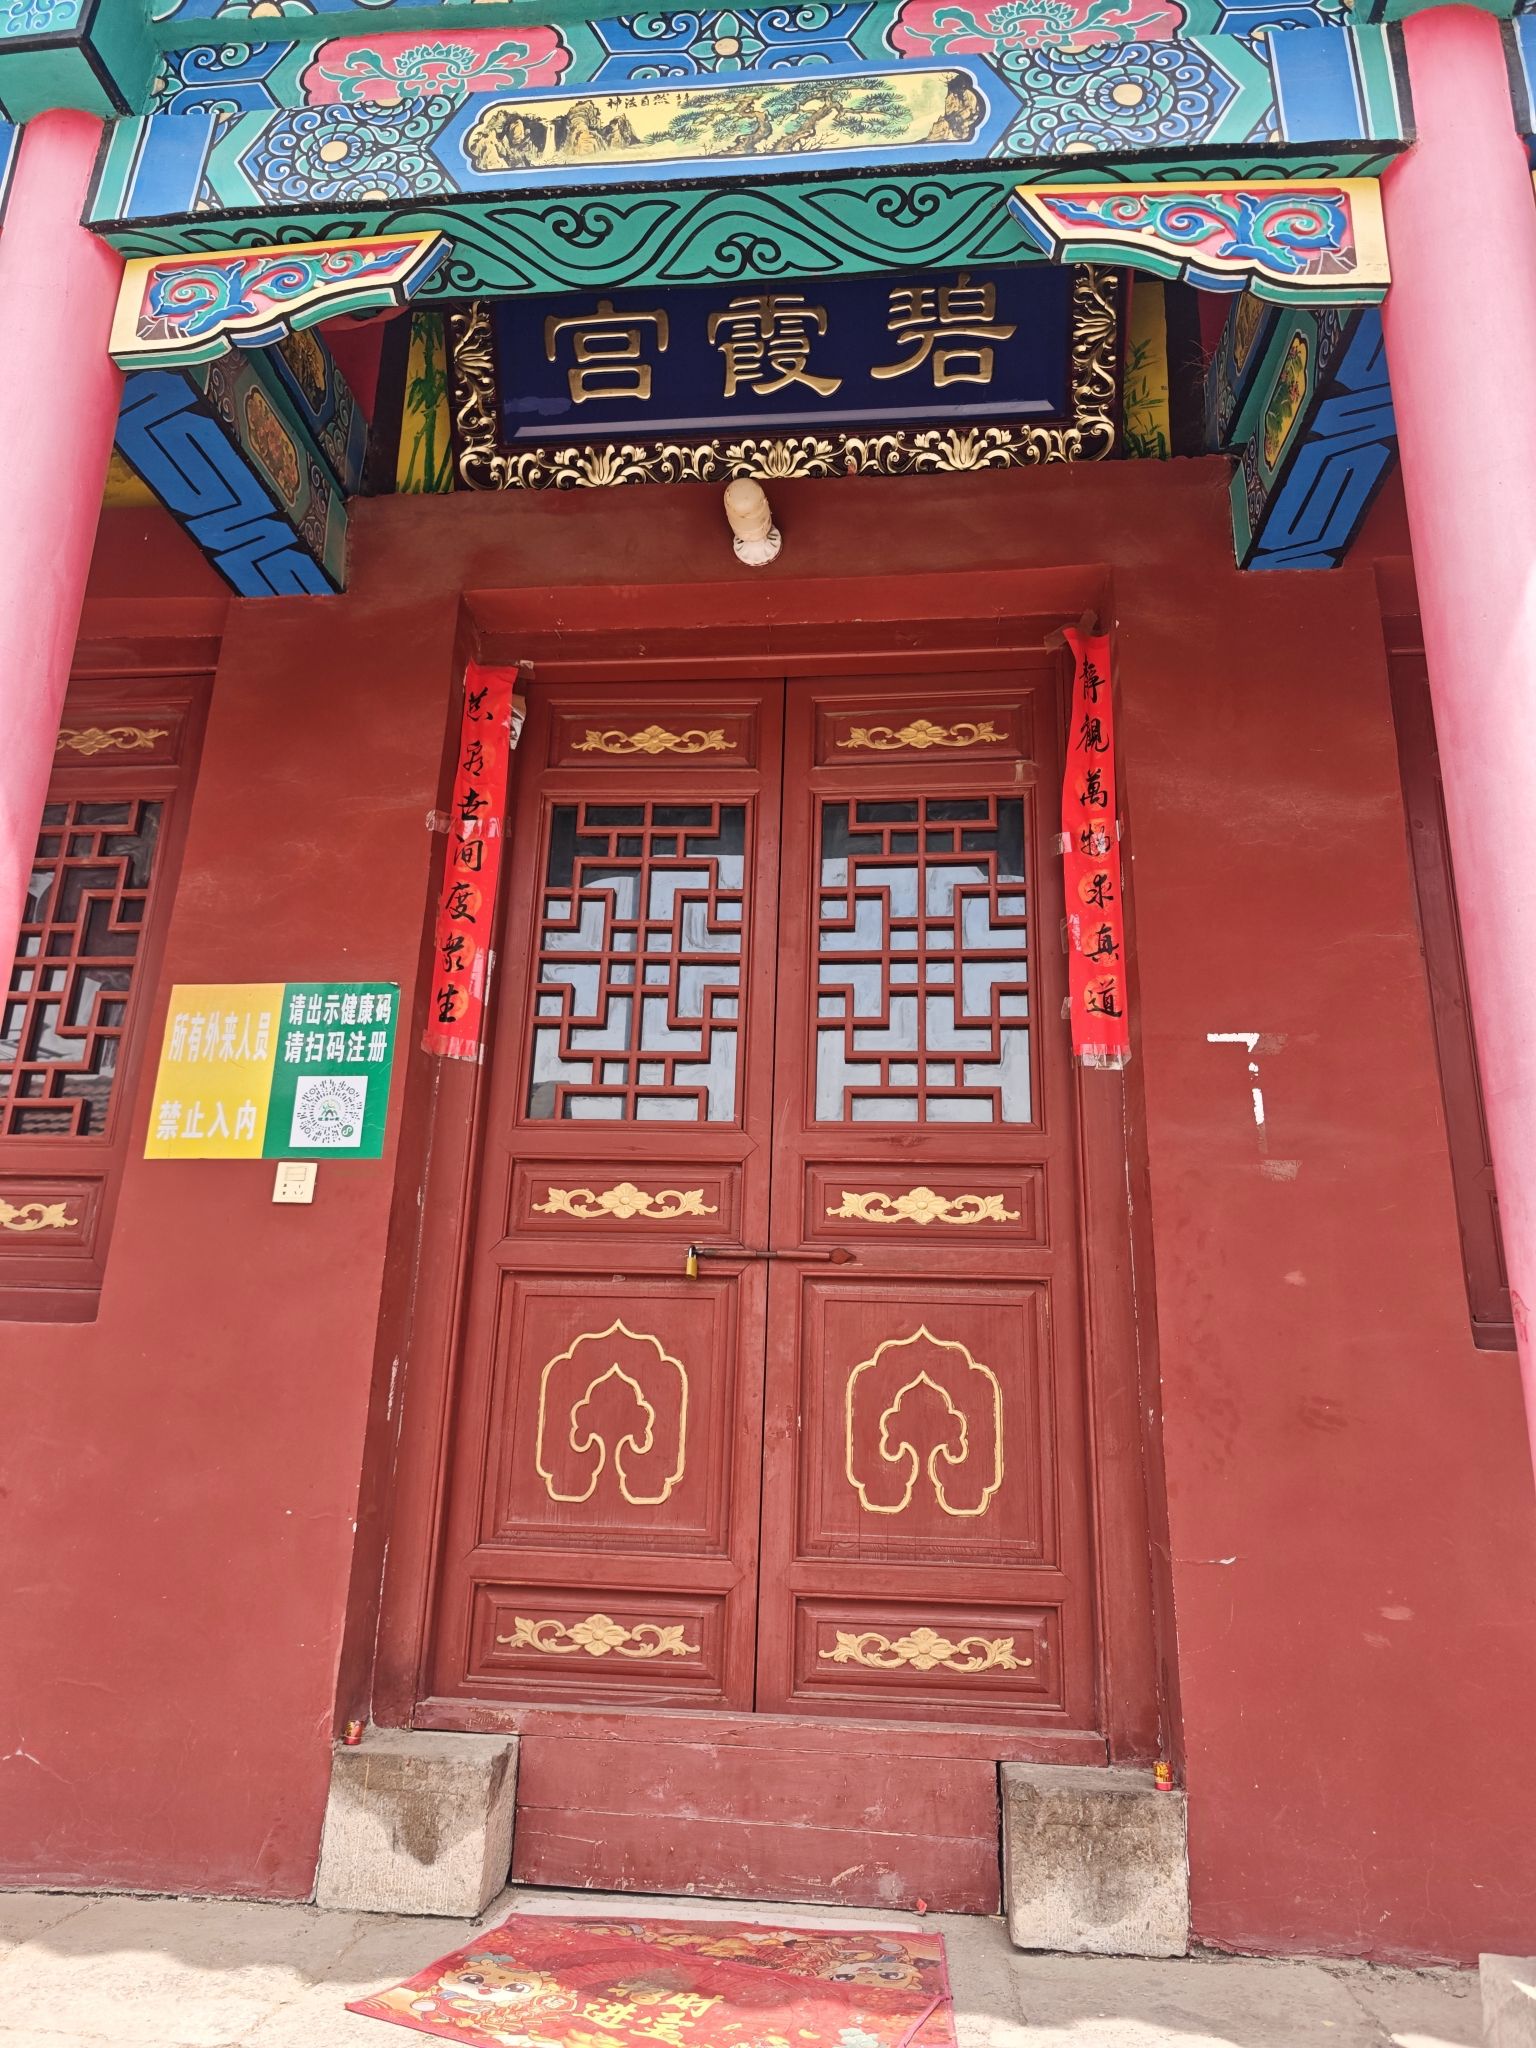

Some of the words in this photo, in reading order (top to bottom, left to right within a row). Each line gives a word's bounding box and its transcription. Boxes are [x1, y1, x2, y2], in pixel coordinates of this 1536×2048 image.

[288, 993, 392, 1026] 请出示健康码
[167, 1011, 271, 1063] 所有外来人员
[284, 1031, 388, 1064] 请扫码注册
[156, 1099, 257, 1141] 禁止入内
